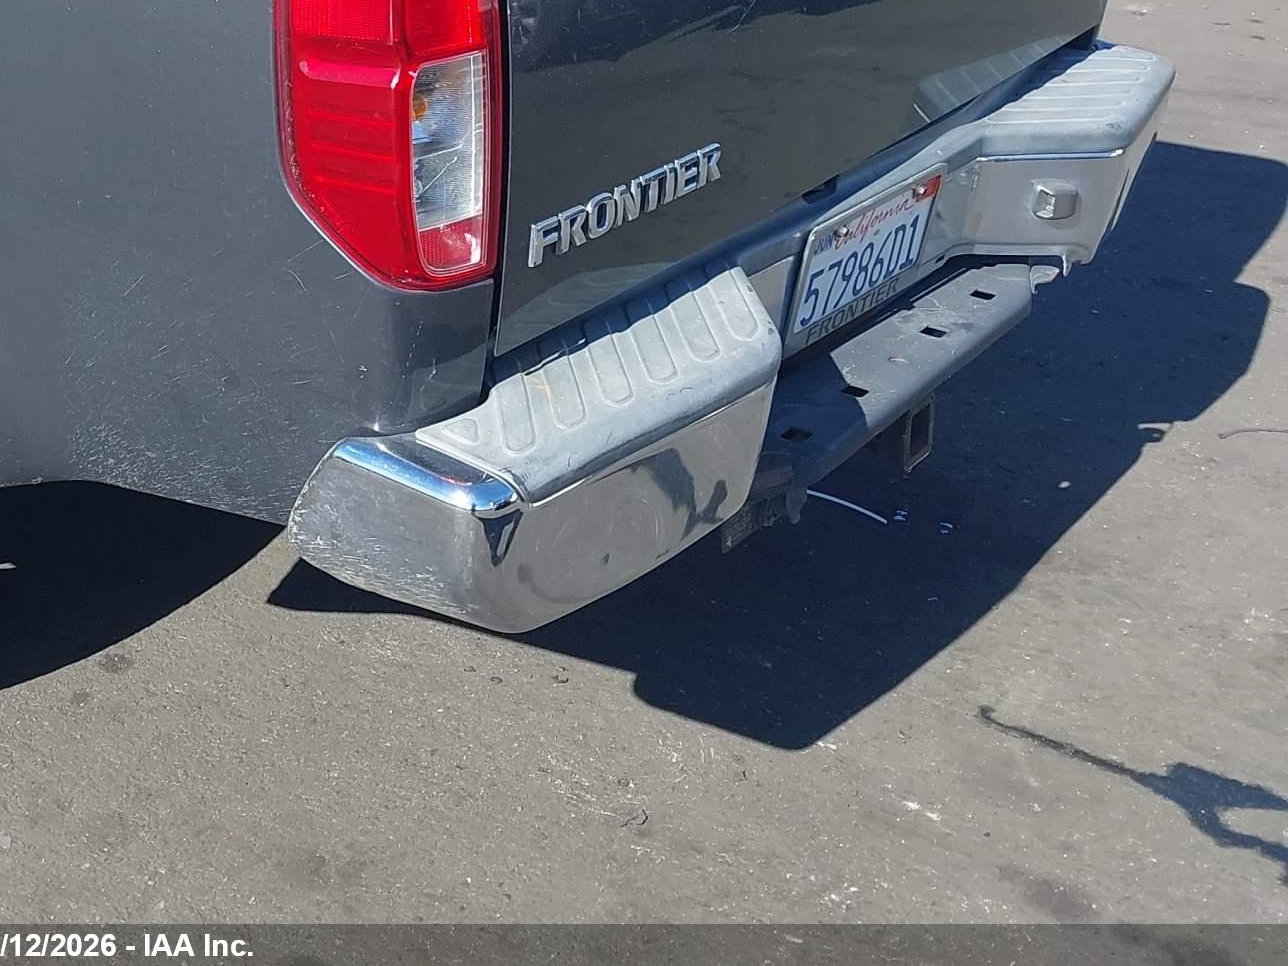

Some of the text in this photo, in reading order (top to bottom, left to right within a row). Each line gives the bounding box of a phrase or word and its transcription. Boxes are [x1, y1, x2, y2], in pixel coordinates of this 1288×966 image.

[527, 142, 722, 268] FRONTIER
[799, 214, 919, 327] 57986D1
[805, 277, 900, 344] FRONTIER
